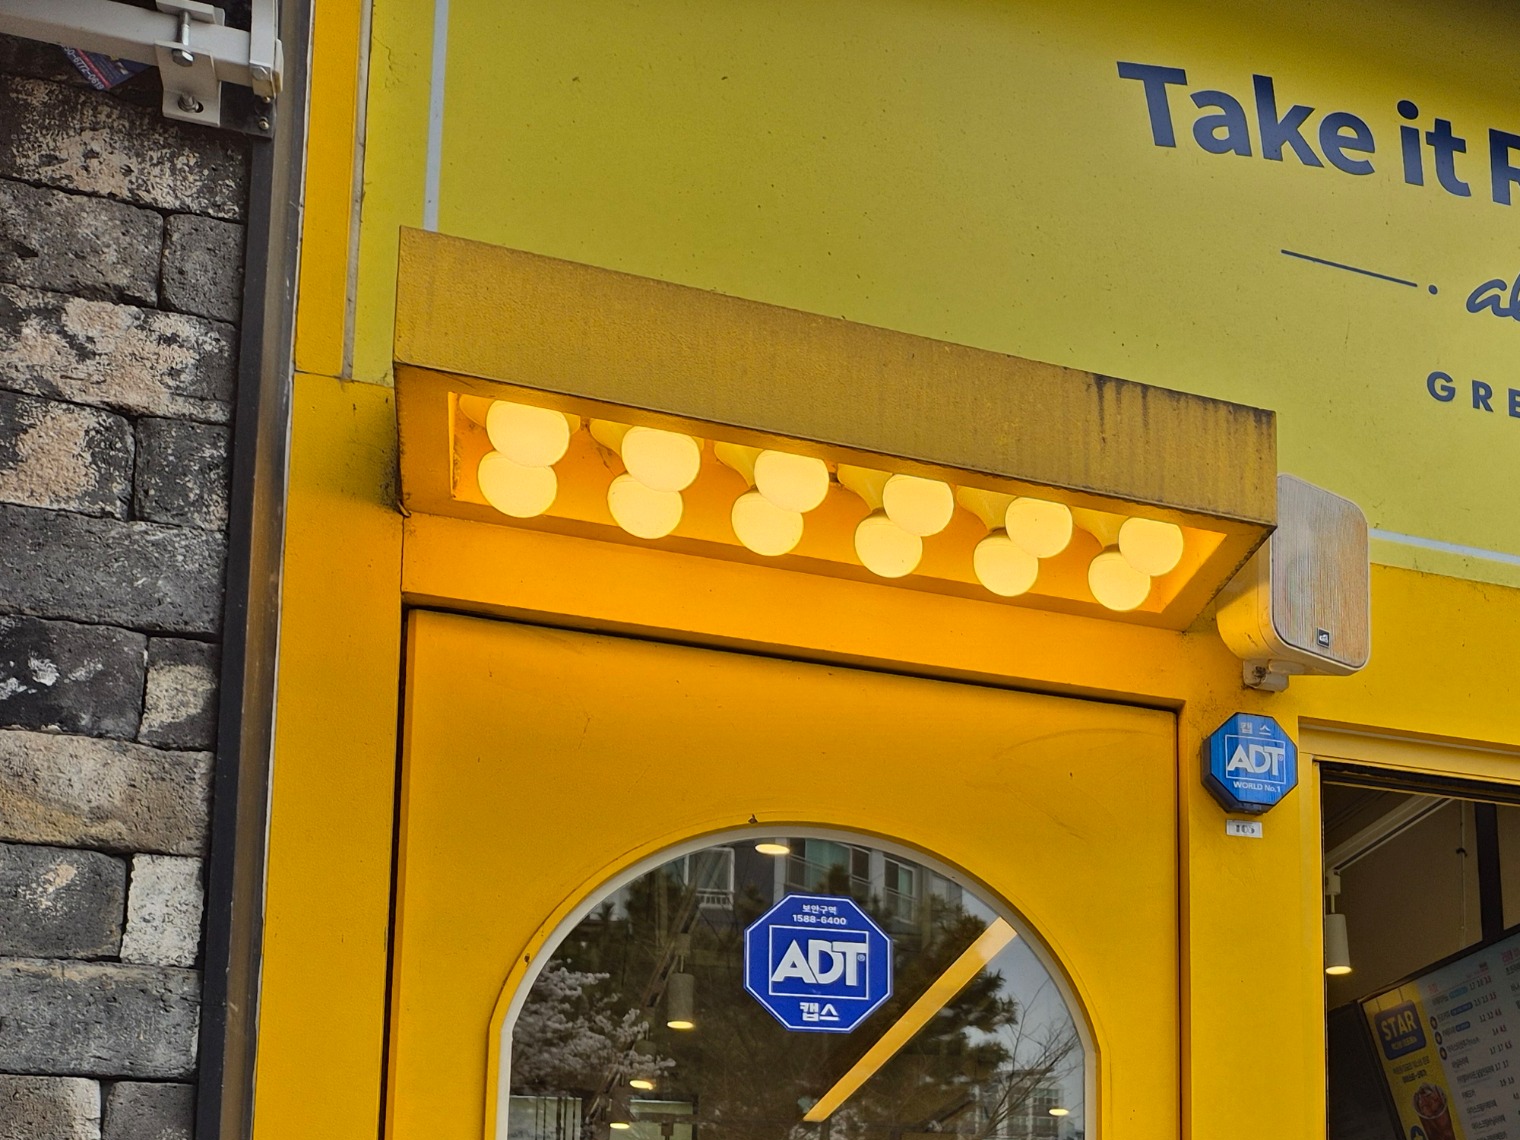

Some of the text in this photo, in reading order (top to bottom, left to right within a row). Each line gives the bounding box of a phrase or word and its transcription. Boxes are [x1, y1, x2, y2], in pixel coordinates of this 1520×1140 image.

[1117, 61, 1376, 175] Take
[1397, 99, 1471, 197] it
[1227, 744, 1284, 776] ADT
[1233, 781, 1263, 791] WORLD
[792, 914, 847, 926] 1588-6400
[802, 904, 837, 915] 보안구역
[771, 939, 868, 986] ADT
[800, 1002, 840, 1021] 캡스
[1381, 1010, 1417, 1041] STAR
